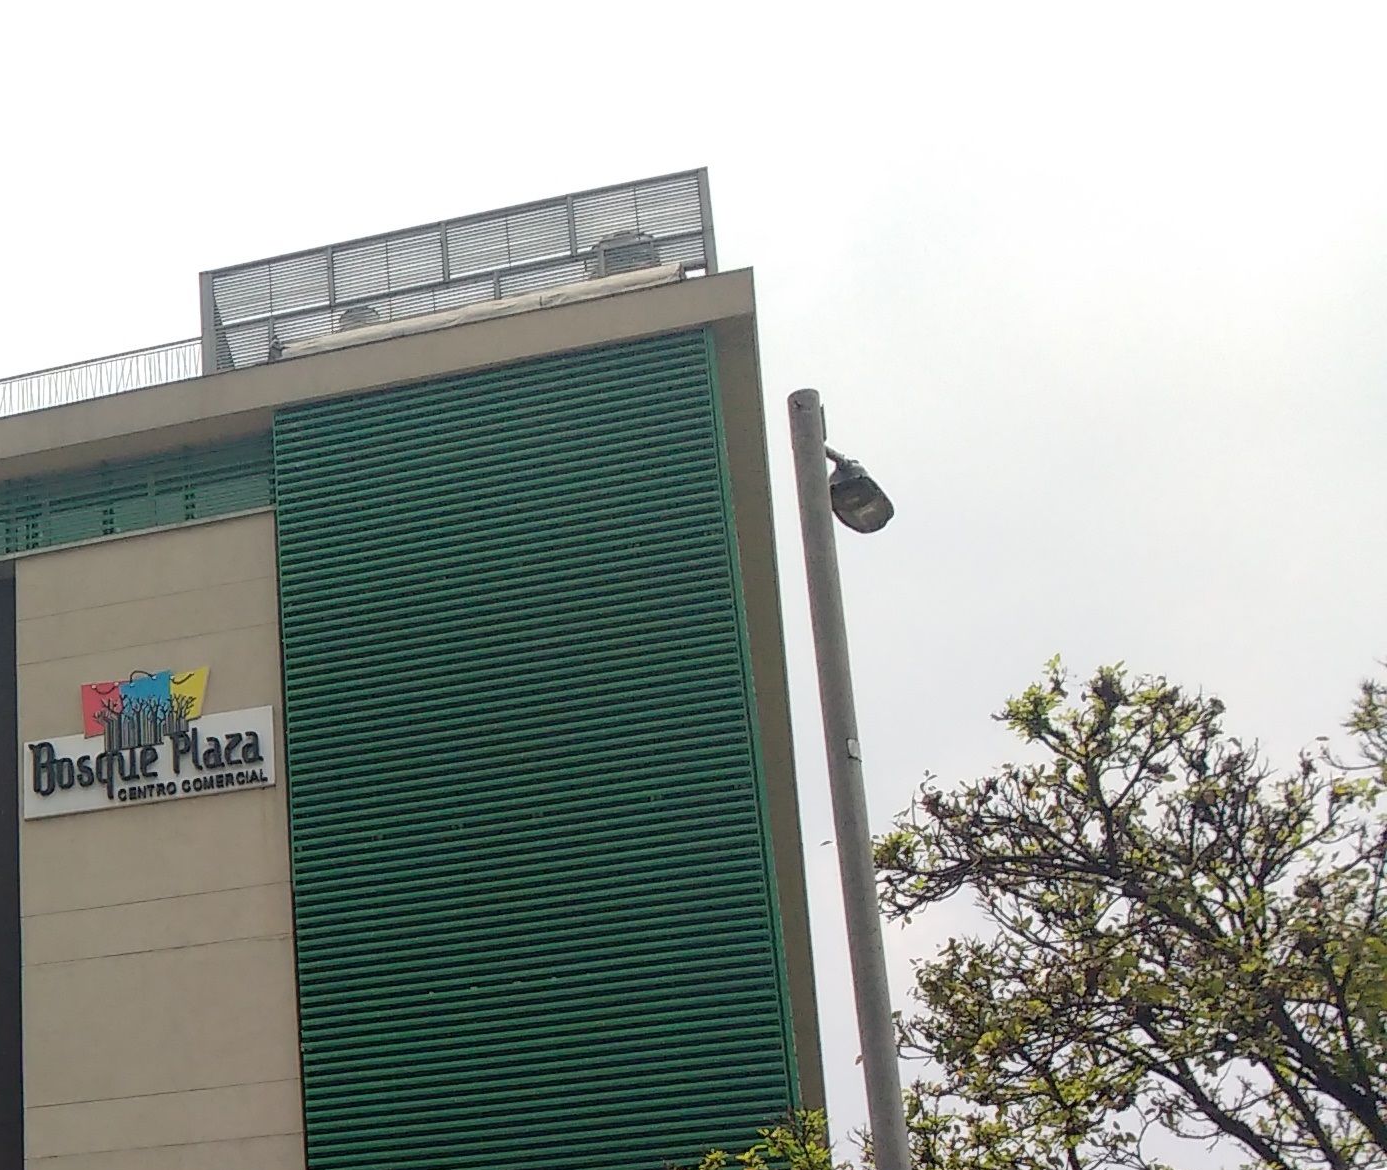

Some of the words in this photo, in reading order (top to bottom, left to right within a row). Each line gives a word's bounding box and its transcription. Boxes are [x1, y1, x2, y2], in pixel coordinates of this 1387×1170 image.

[28, 740, 159, 800] Bosque
[170, 727, 264, 775] Plaza
[117, 780, 177, 802] CENTRO
[181, 768, 269, 793] COMERCIAL
